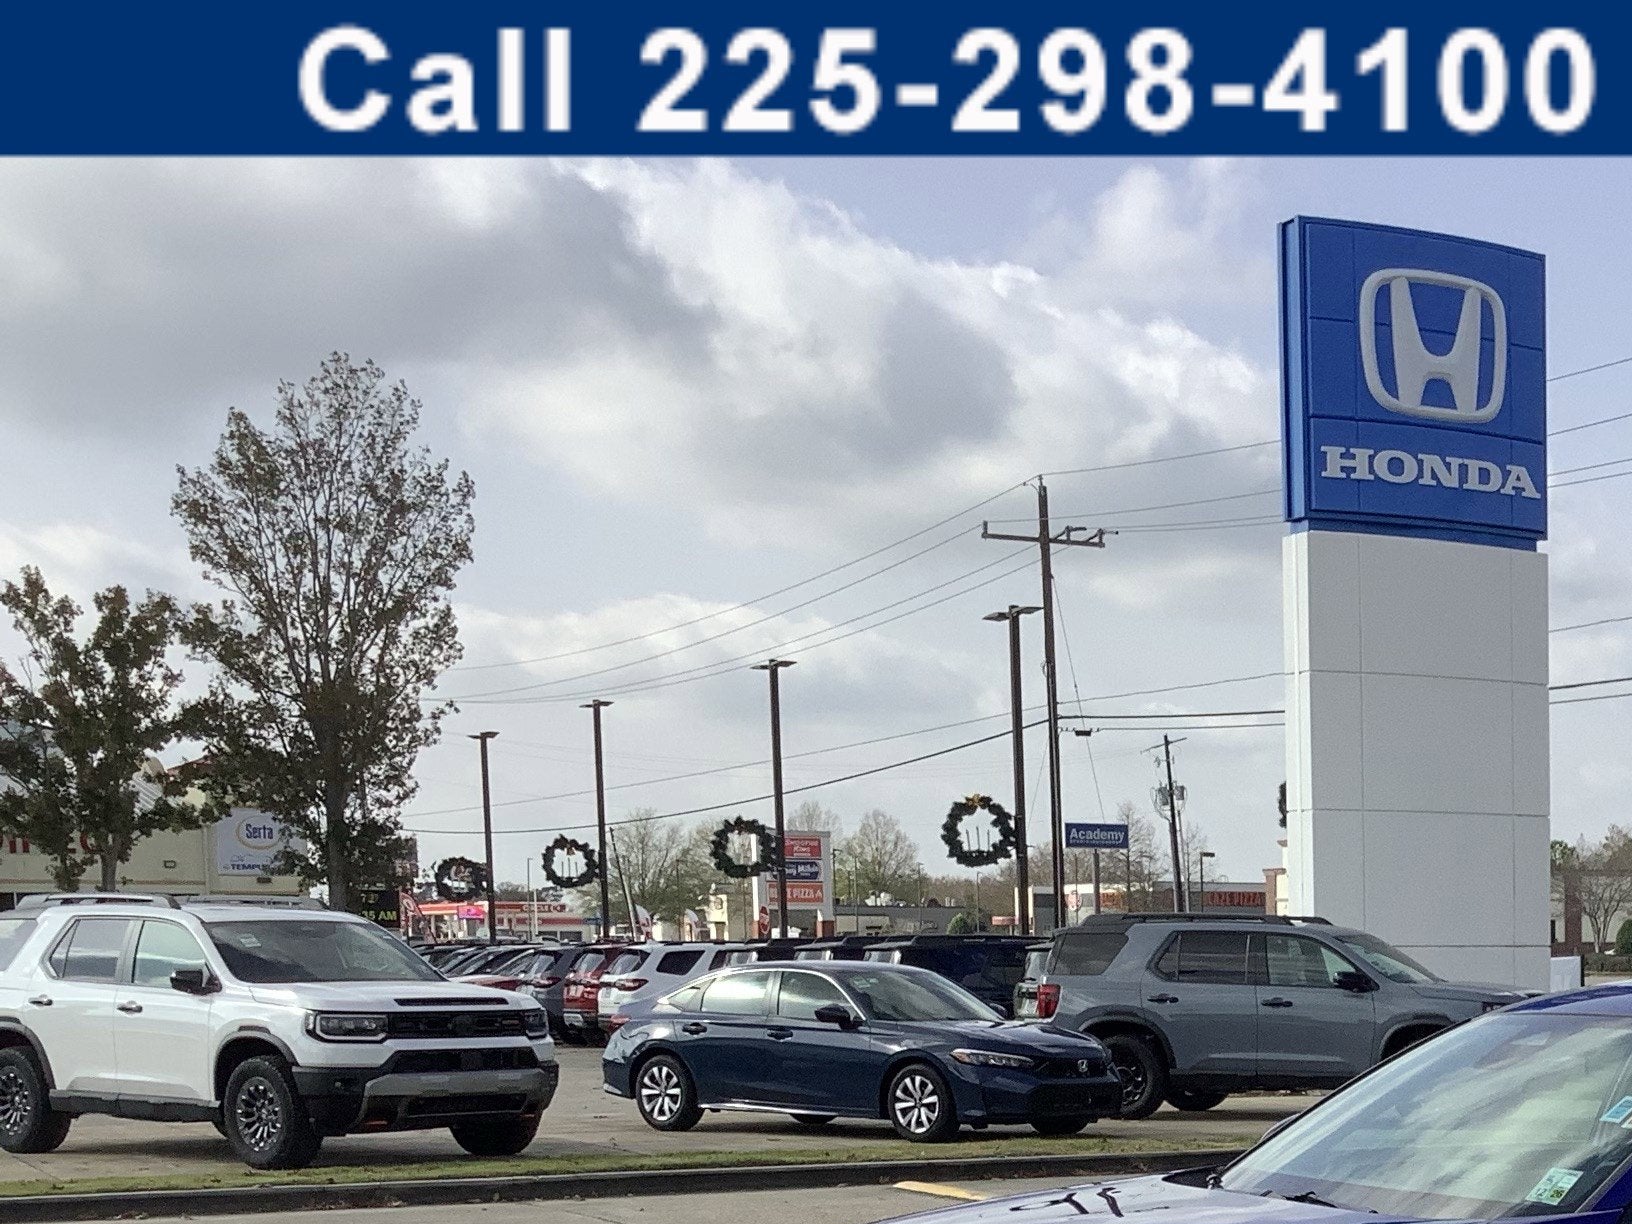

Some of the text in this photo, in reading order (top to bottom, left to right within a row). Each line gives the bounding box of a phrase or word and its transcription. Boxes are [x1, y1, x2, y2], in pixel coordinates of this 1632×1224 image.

[1320, 445, 1541, 499] HONDA
[245, 822, 274, 840] Serta
[1069, 828, 1125, 844] Academy
